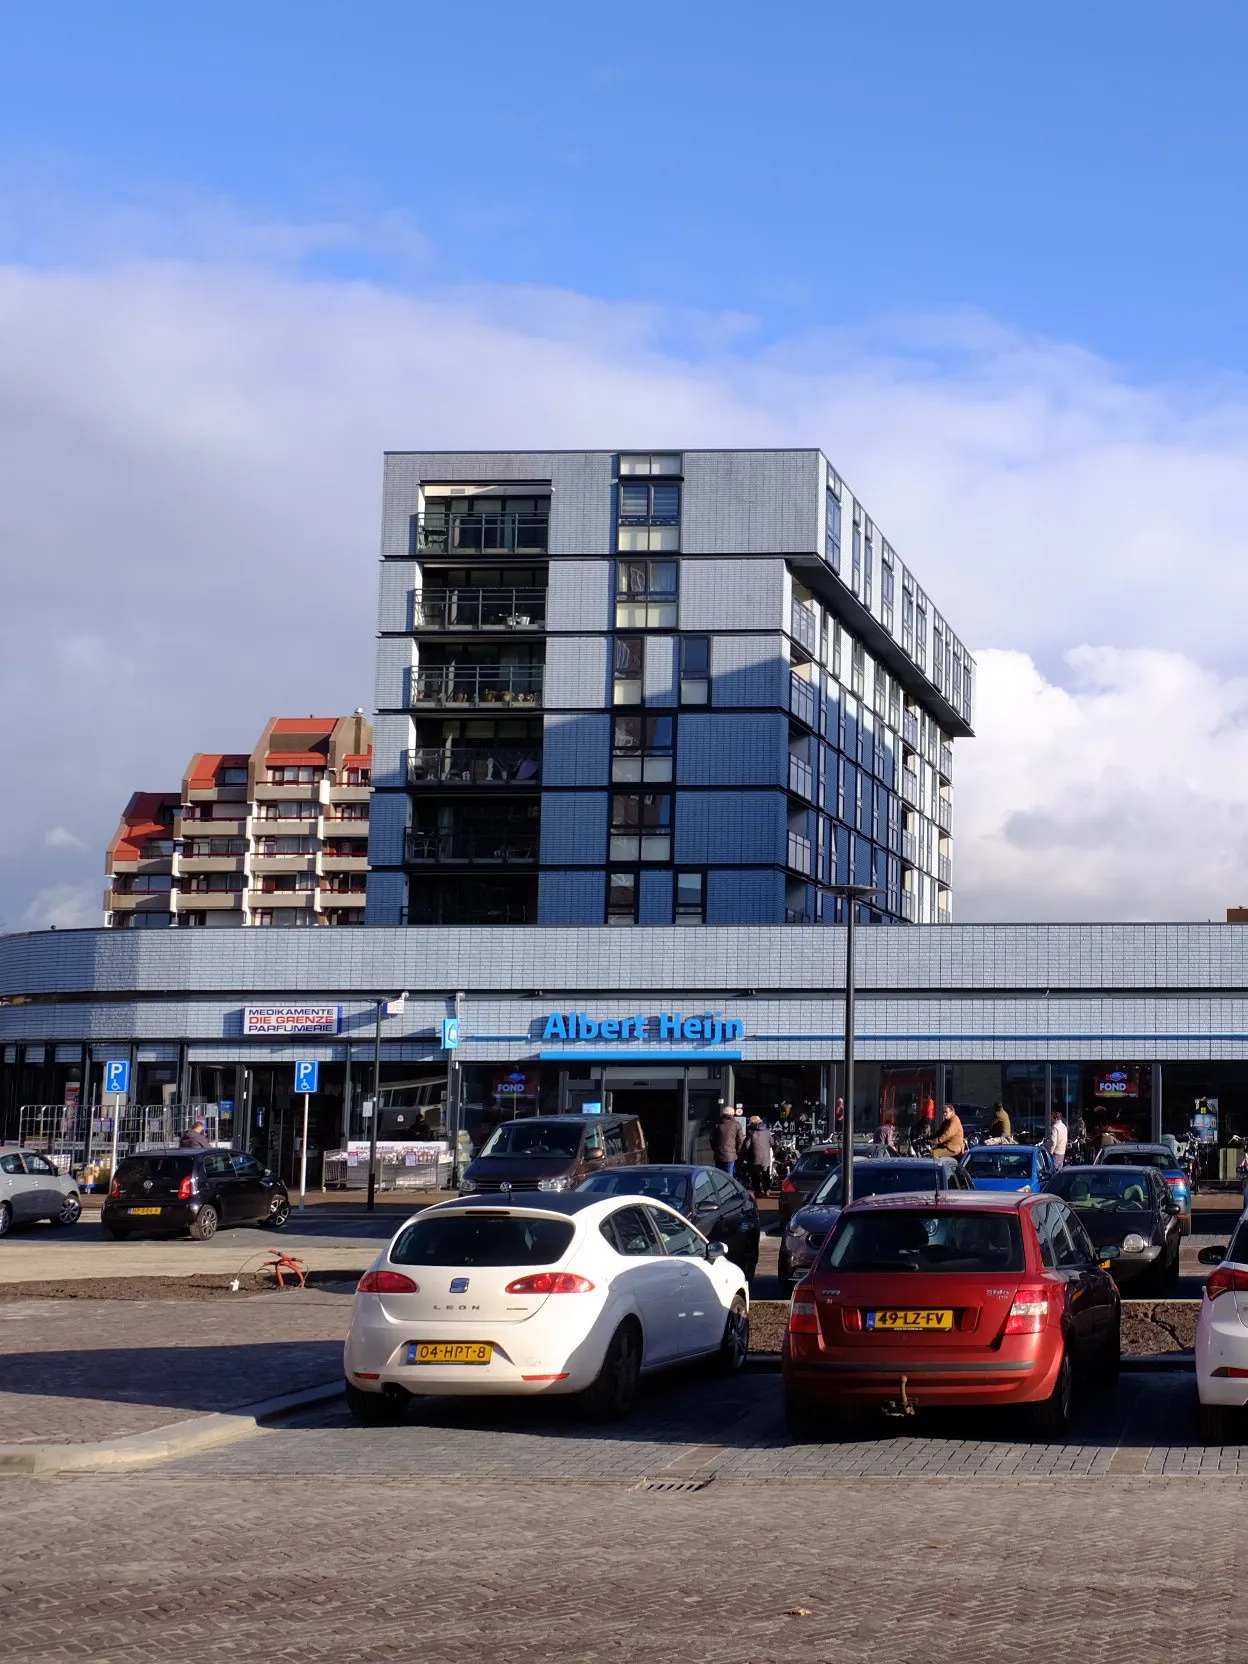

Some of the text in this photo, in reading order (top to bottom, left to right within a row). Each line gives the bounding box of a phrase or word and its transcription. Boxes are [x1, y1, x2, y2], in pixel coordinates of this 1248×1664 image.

[248, 1008, 334, 1016] MEDIKAMENTE
[248, 1016, 334, 1024] DIE GRENZE
[542, 1010, 744, 1045] Albert Heijn
[111, 1063, 123, 1079] P
[300, 1063, 312, 1079] P
[1100, 1083, 1126, 1091] FOND
[877, 1311, 945, 1325] 49-LZ-FV
[420, 1346, 486, 1358] 04-HPT-8
